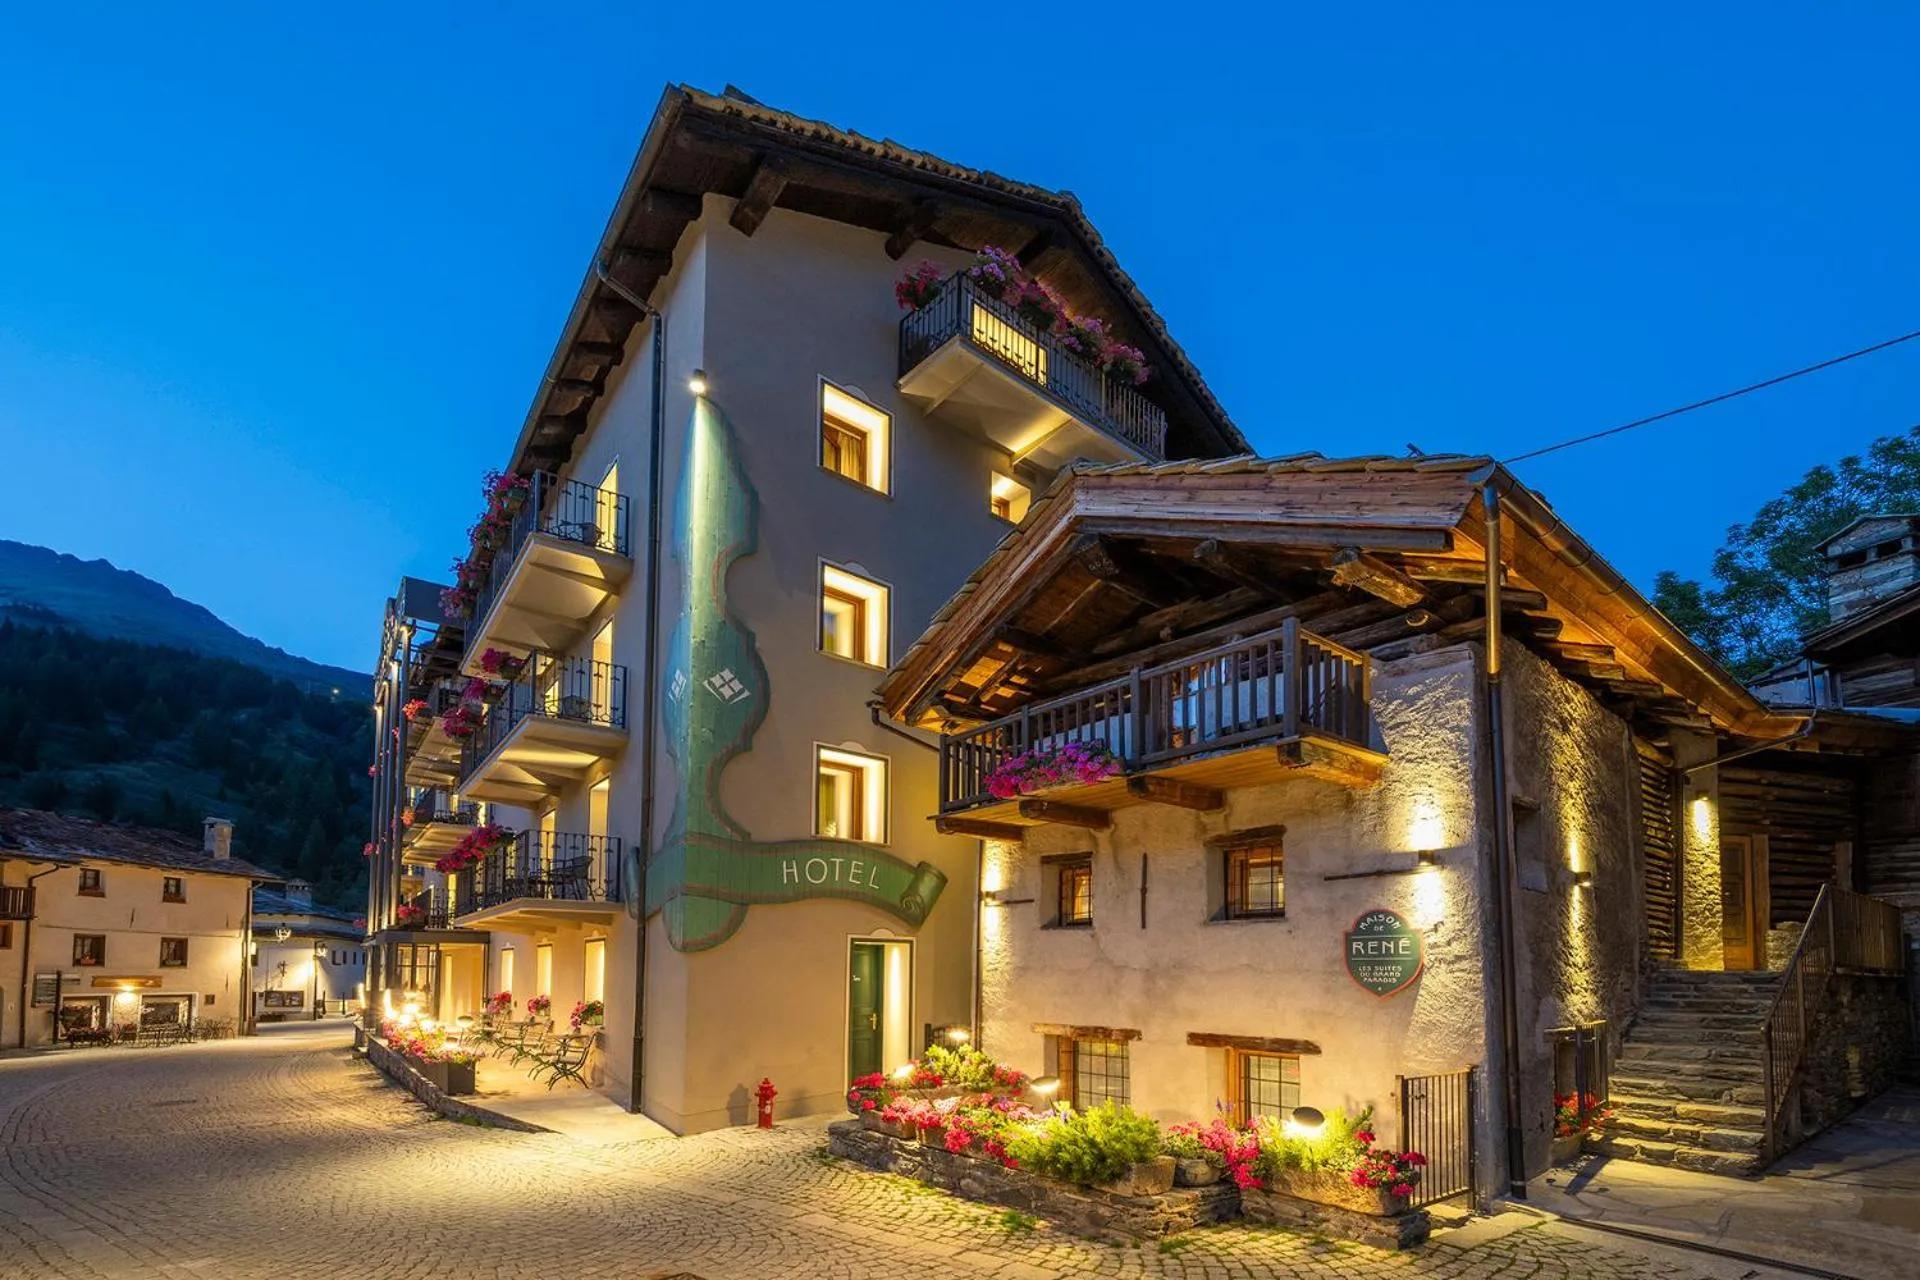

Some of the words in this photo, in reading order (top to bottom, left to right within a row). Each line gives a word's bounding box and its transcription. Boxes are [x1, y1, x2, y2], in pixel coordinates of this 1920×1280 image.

[783, 858, 879, 889] HOTEL
[1359, 914, 1402, 930] MAISON
[1352, 937, 1411, 955] RENÉ
